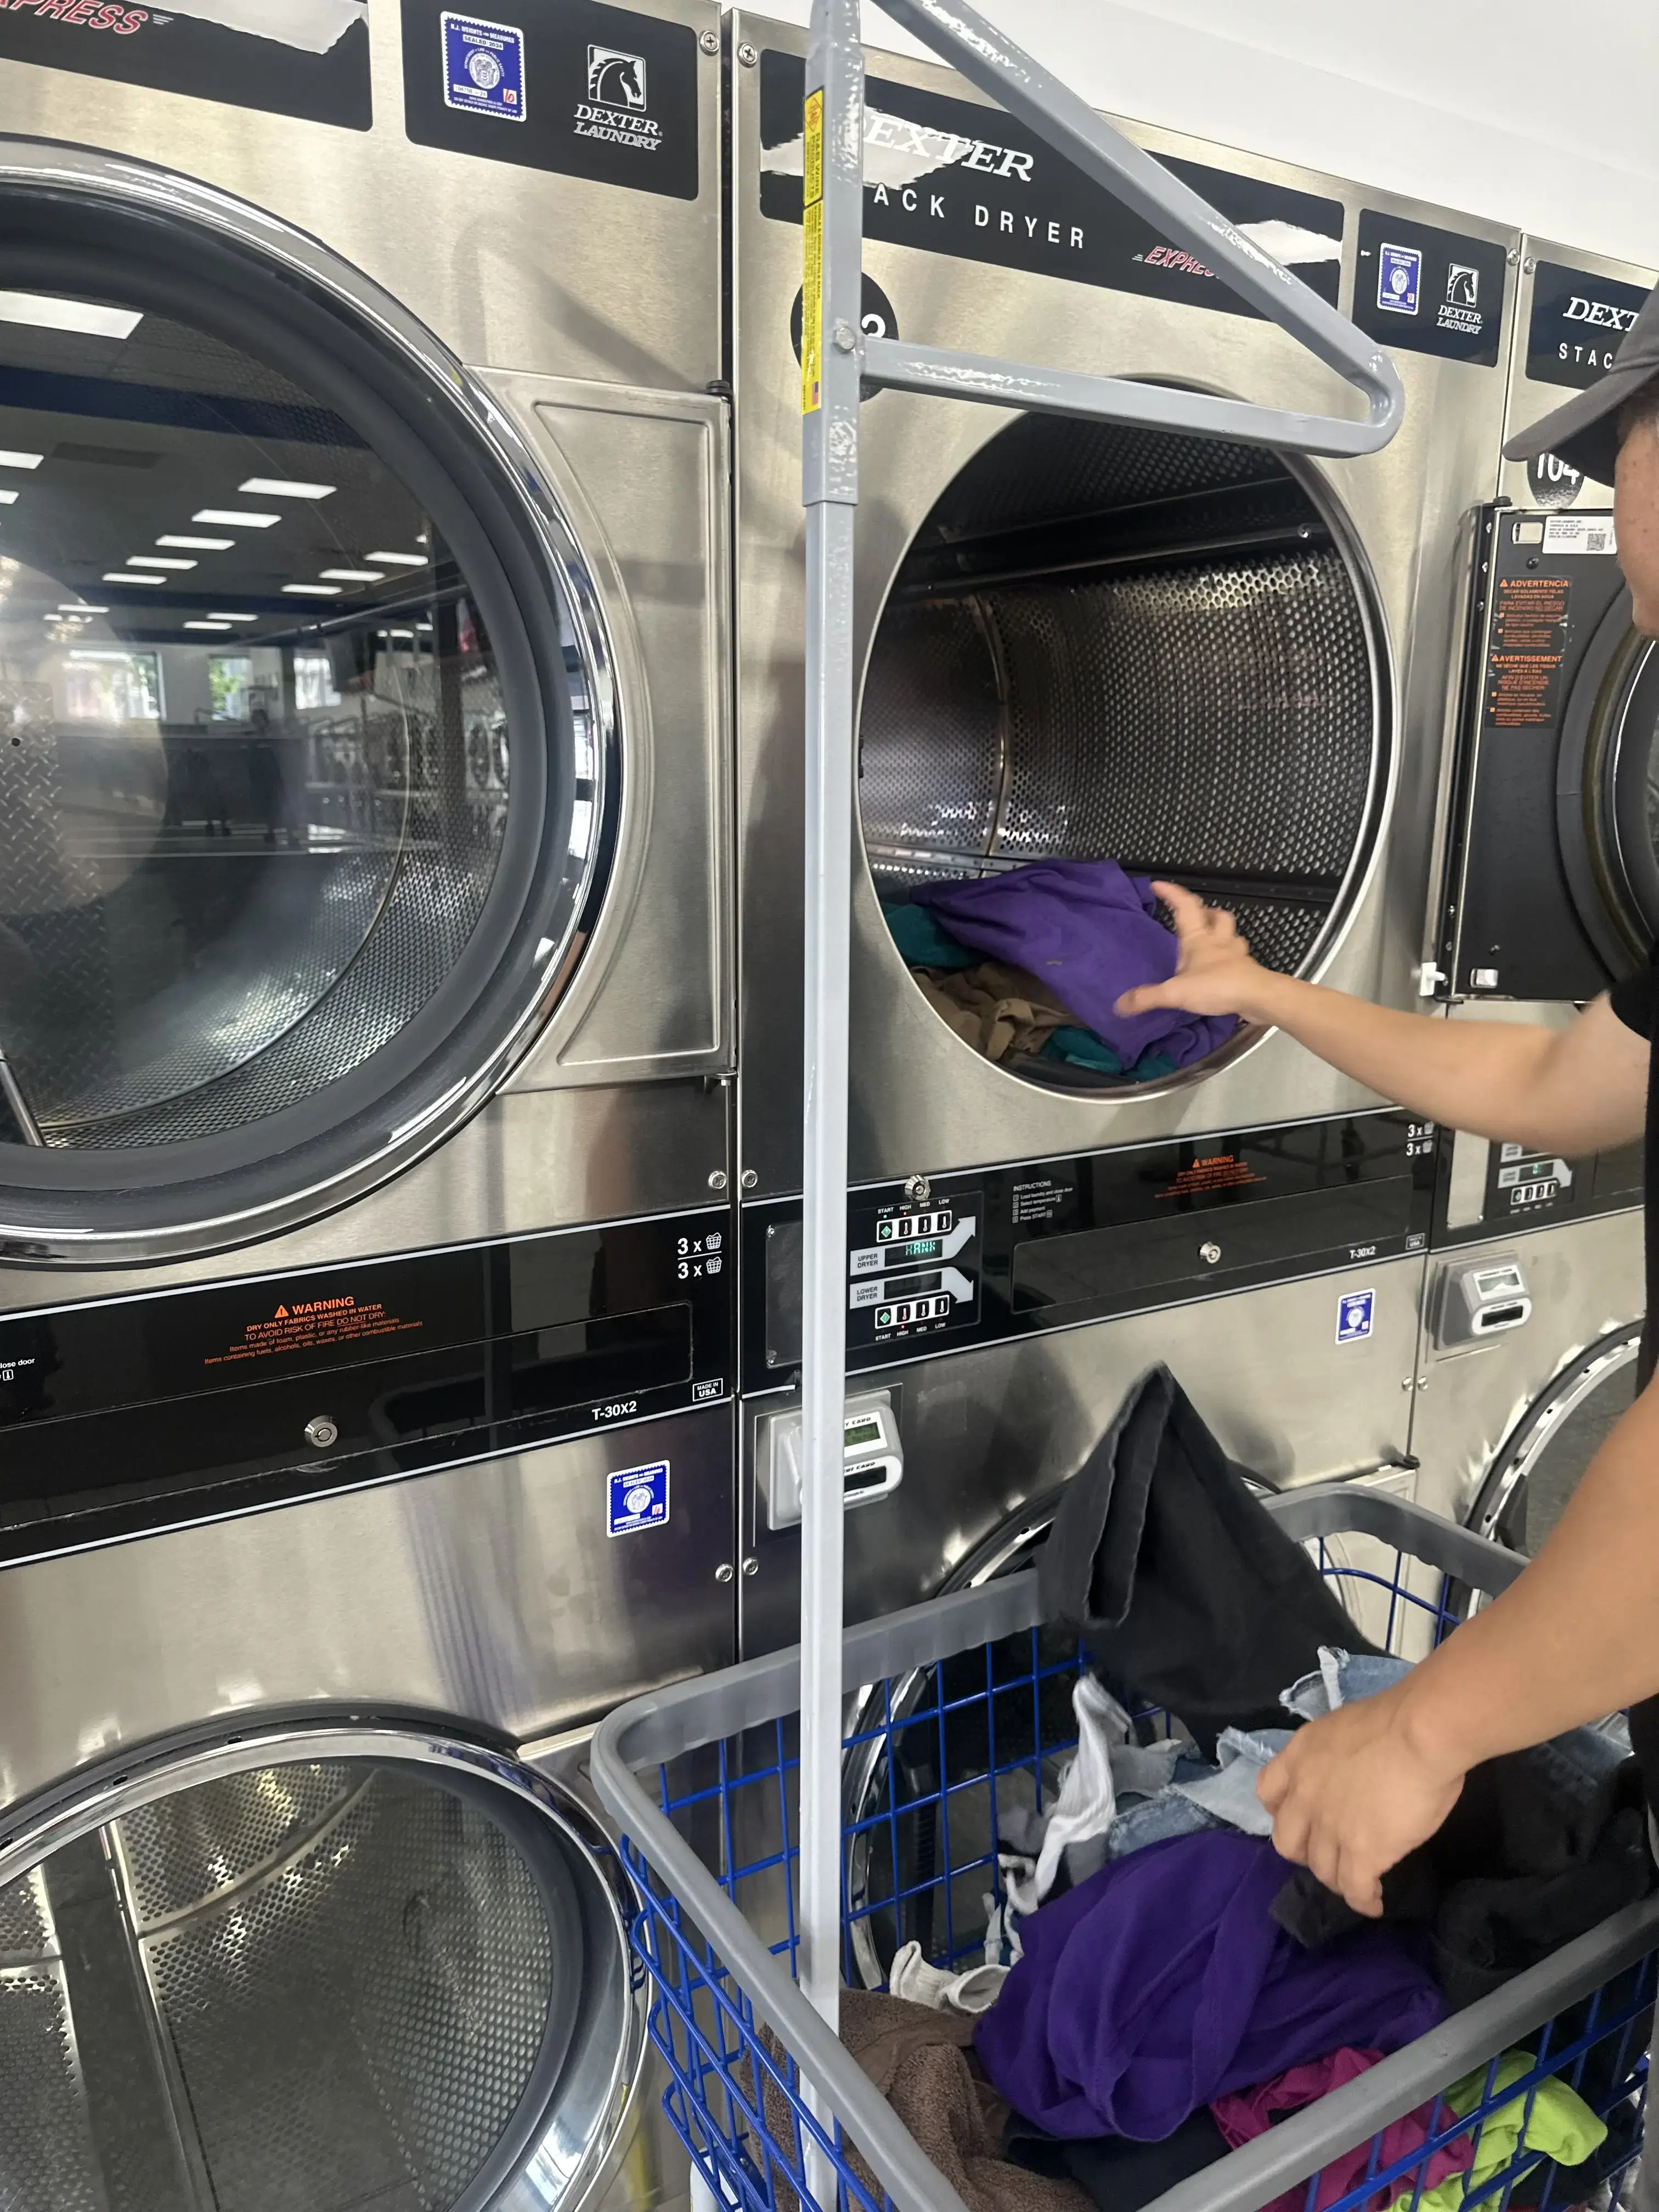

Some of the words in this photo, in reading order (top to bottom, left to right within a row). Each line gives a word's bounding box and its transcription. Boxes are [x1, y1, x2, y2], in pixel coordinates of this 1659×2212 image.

[461, 26, 482, 36] WEIGHTS
[490, 33, 515, 43] MEASURES
[464, 36, 486, 45] SEALED
[574, 104, 659, 136] DEXTER
[574, 122, 662, 151] LAUNDRY
[863, 114, 1034, 182] EXTER
[873, 183, 945, 218] ACK
[975, 205, 1084, 249] DRYER
[1144, 246, 1215, 277] EXPRE
[1438, 305, 1481, 324] DEXTER
[1562, 297, 1639, 332] DEXT
[1436, 317, 1482, 334] LAUNDRY
[1559, 343, 1612, 369] STAC
[1538, 453, 1580, 485] 104
[1408, 1124, 1414, 1137] 3
[1406, 1142, 1414, 1156] 3
[1201, 1155, 1233, 1166] WARNING
[678, 1238, 689, 1255] 3
[693, 1240, 702, 1252] x
[1350, 1245, 1376, 1259] T-30X2
[857, 1260, 878, 1268] DRYER
[858, 1253, 878, 1261] UPPER
[678, 1262, 689, 1279] 3
[693, 1265, 702, 1277] x
[857, 1286, 878, 1295] LOWER
[857, 1293, 877, 1301] DRYER
[292, 1296, 354, 1315] WARNING
[247, 1324, 262, 1332] DRY
[264, 1321, 283, 1330] ONLY
[284, 1315, 315, 1327] FABRICS
[317, 1310, 347, 1320] WASHED
[358, 1304, 382, 1312] WATER
[258, 1329, 283, 1339] AVOID
[285, 1325, 303, 1334] RISK
[318, 1320, 335, 1329] FIRE
[351, 1314, 366, 1323] NOT
[340, 1323, 371, 1333] rubber-like
[373, 1318, 399, 1327] materials
[223, 1351, 255, 1361] containing
[362, 1326, 396, 1336] combustible
[397, 1321, 422, 1330] materials
[699, 1388, 716, 1397] USA
[592, 1401, 637, 1420] T-30X2
[856, 1462, 876, 1470] CARD
